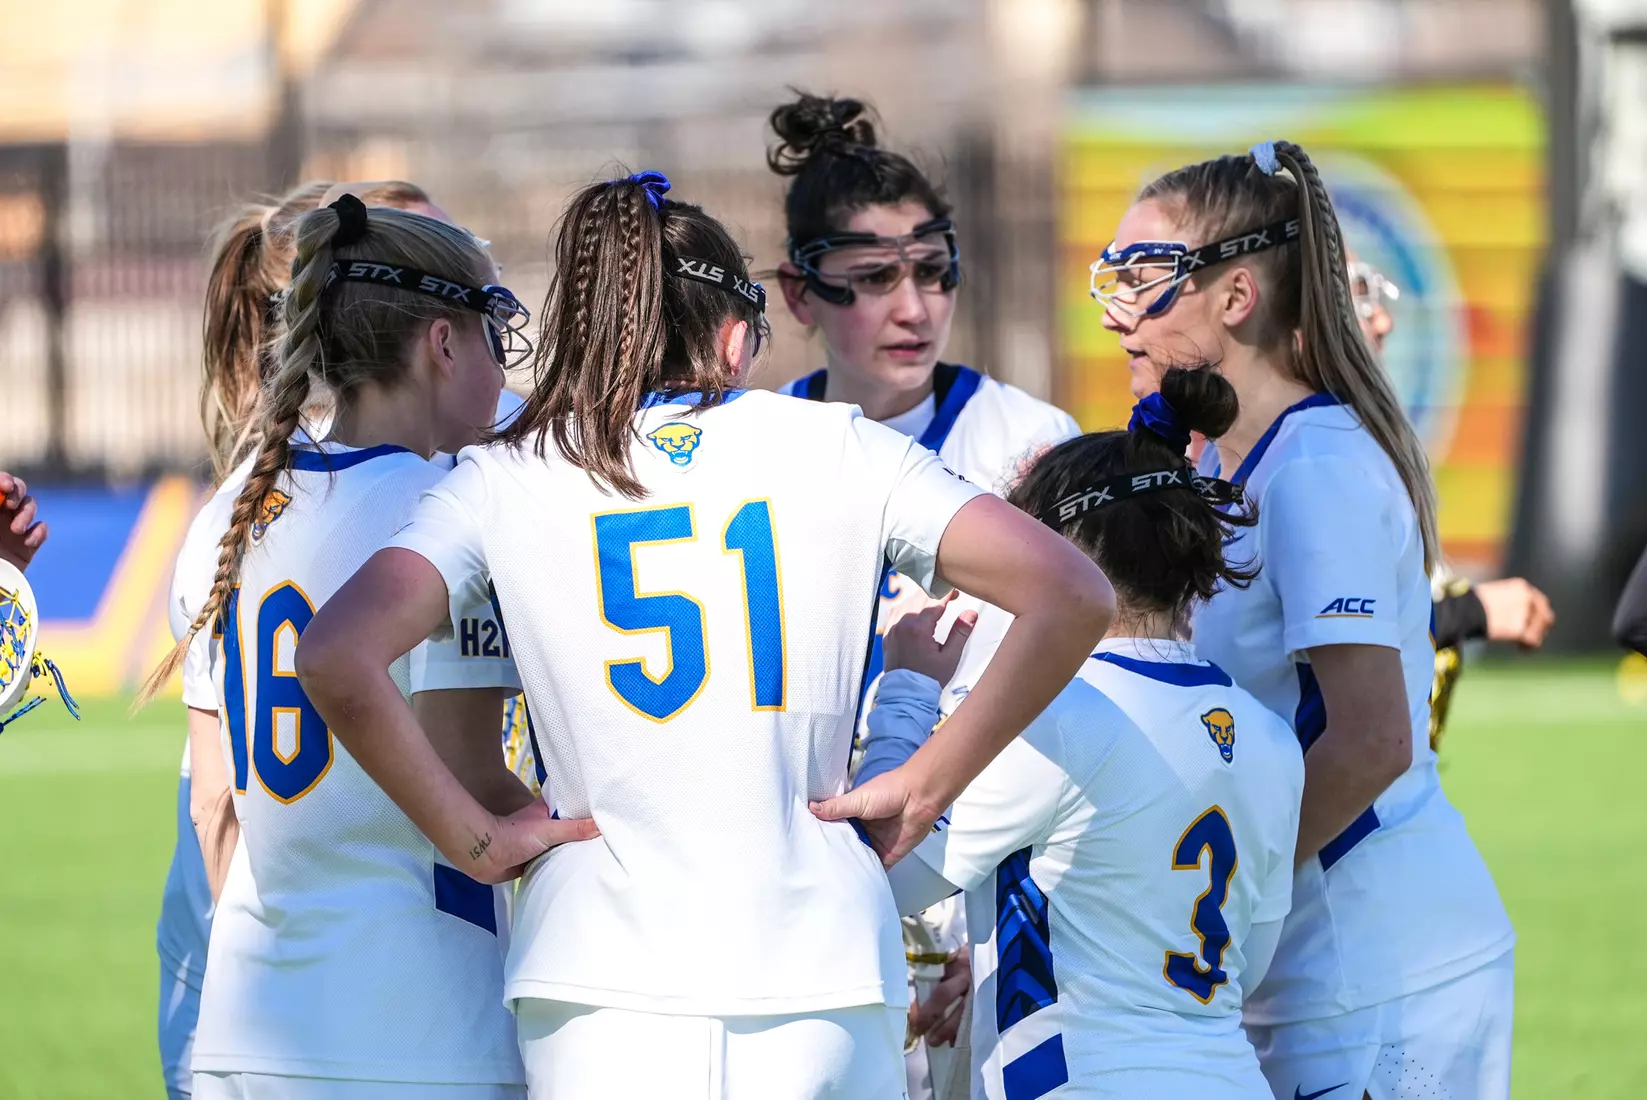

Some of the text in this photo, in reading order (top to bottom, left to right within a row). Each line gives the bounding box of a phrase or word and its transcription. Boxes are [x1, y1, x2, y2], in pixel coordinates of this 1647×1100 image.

[1220, 230, 1271, 258] STX
[348, 263, 403, 283] STX
[419, 276, 472, 303] STX
[676, 257, 759, 303] STX STX
[1059, 486, 1114, 523] STX
[1131, 470, 1182, 491] STX
[590, 496, 787, 724] 51
[1320, 598, 1376, 614] ACC
[212, 579, 334, 805] 16
[1163, 804, 1238, 1005] 3
